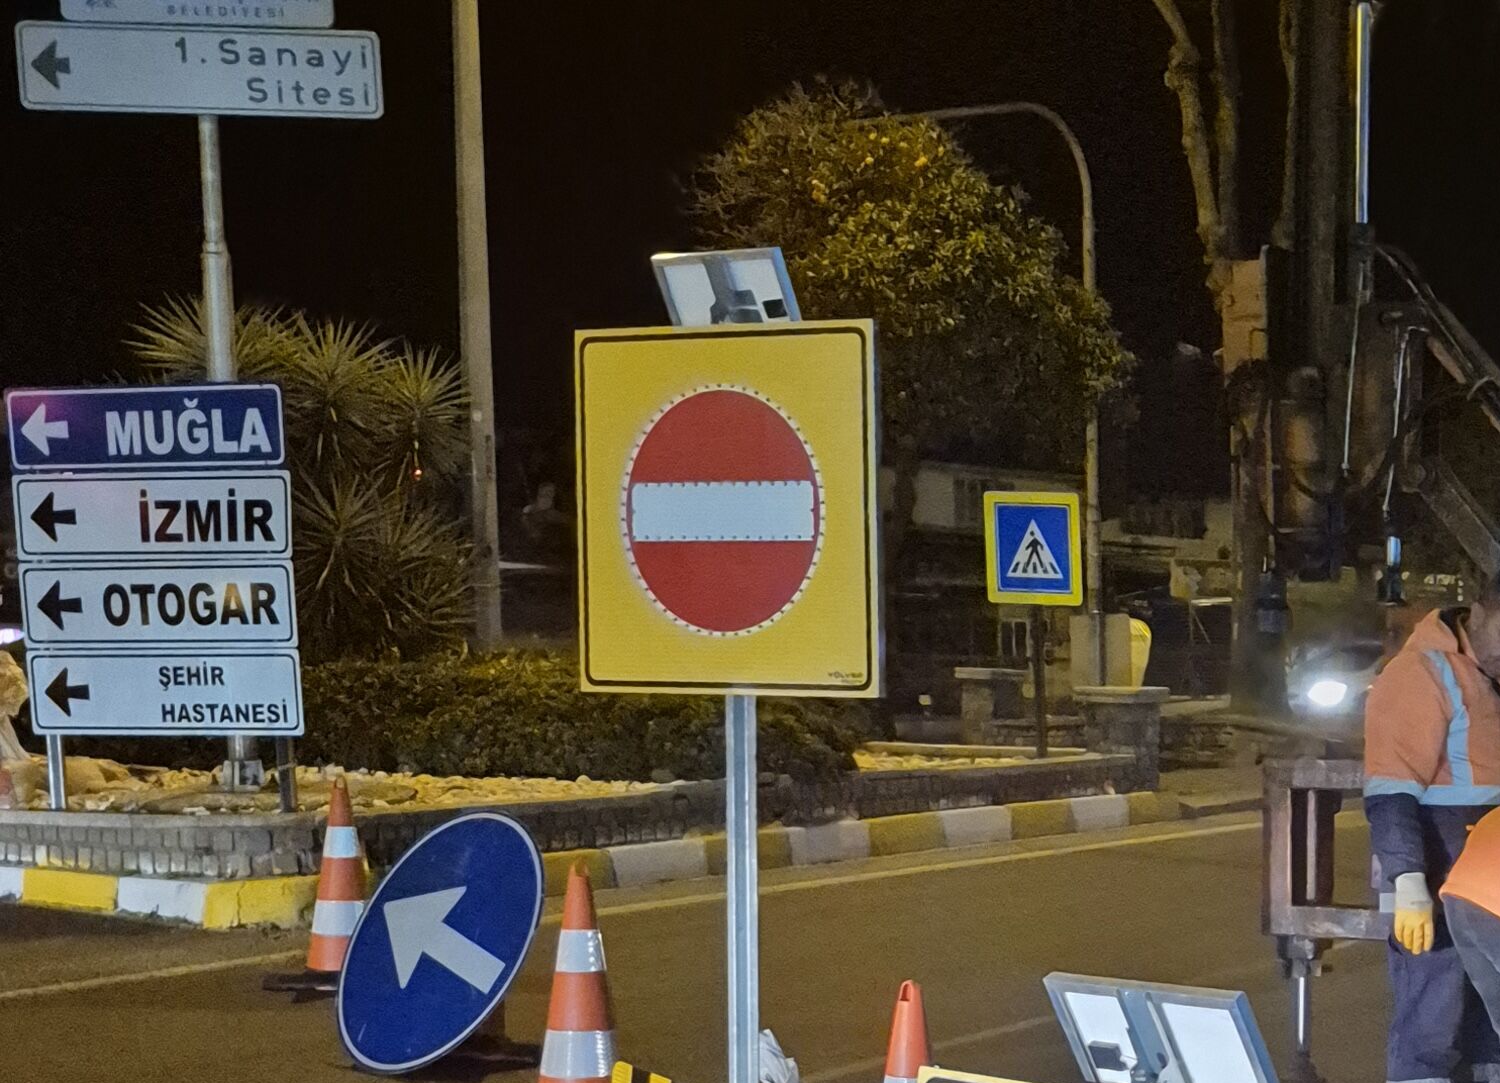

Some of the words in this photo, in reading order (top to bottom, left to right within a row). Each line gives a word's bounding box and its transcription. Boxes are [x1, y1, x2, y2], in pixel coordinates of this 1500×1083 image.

[246, 78, 371, 107] Sitesi
[106, 398, 272, 456] MUĞLA
[139, 488, 276, 543] İZMİR
[103, 582, 280, 627] OTOGAR
[158, 661, 225, 691] ŞEHİR
[161, 699, 289, 724] HASTANESİ
